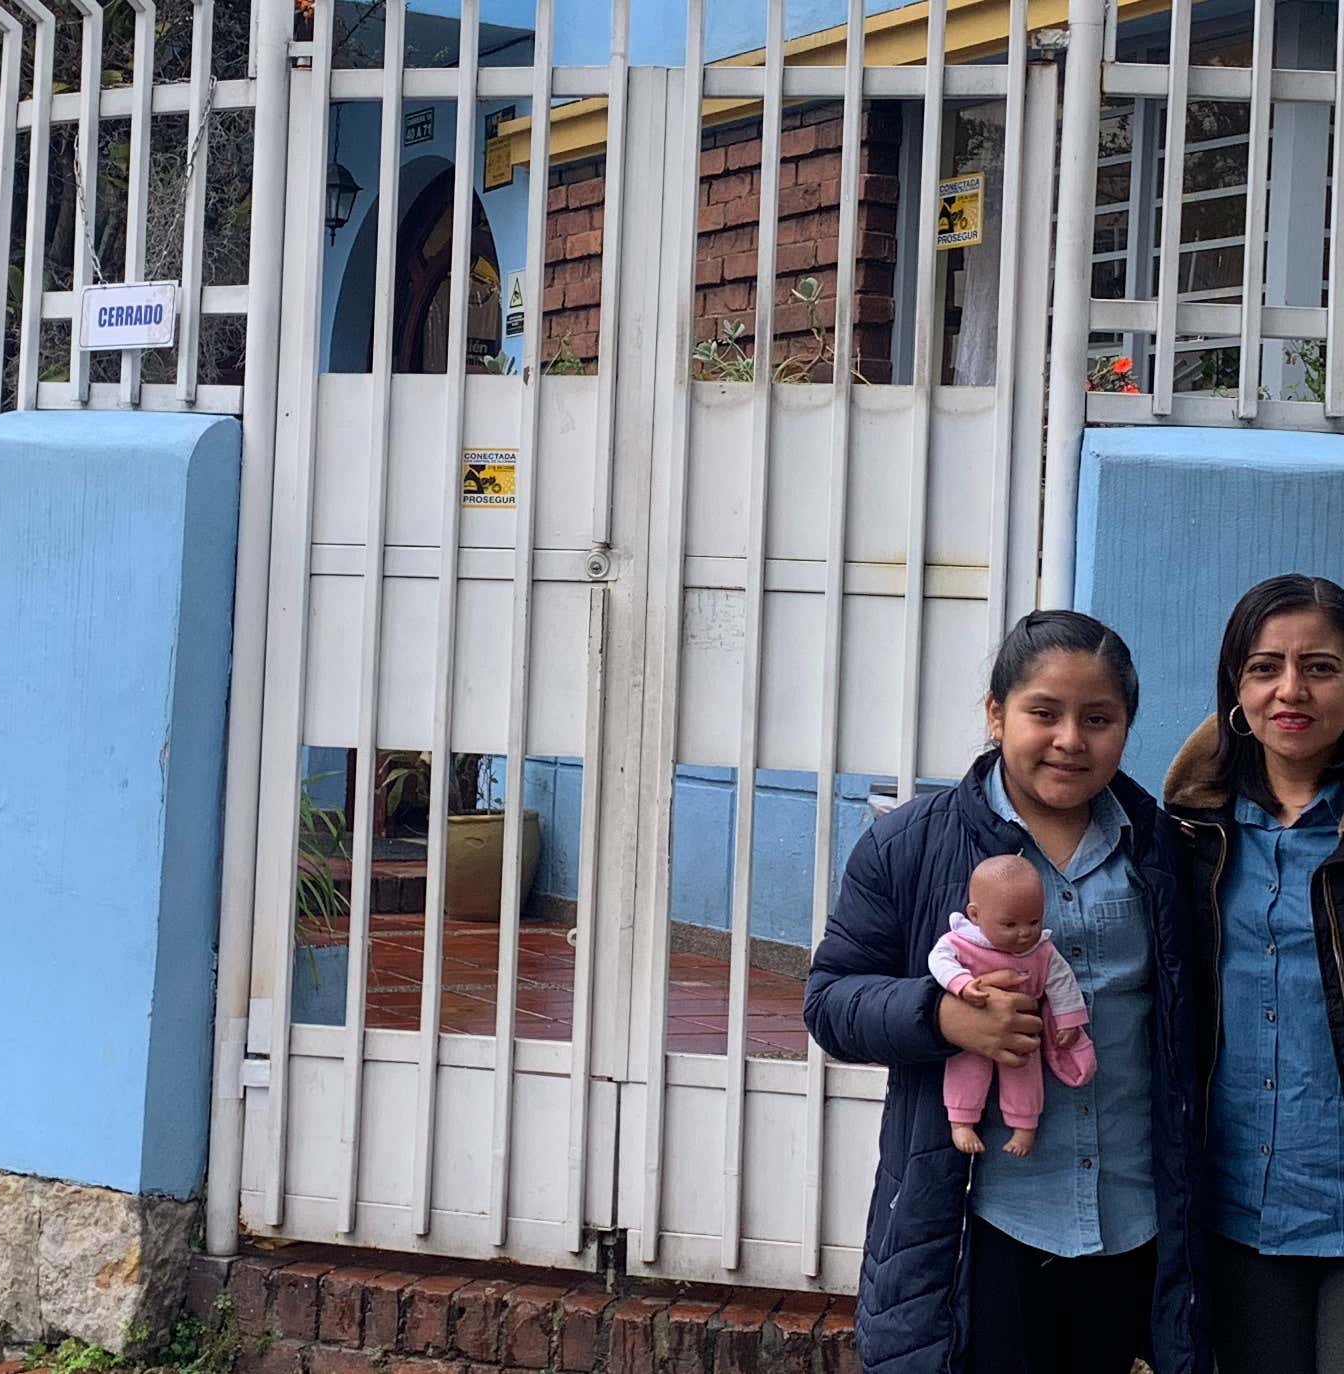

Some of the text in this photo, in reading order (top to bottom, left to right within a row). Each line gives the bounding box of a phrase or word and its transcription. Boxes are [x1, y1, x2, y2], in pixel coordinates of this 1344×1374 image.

[939, 178, 980, 193] CONECTADA
[937, 230, 978, 245] PROSEGUR
[98, 303, 163, 327] CERRADO
[464, 452, 516, 460] CONECTADA
[463, 495, 516, 504] PROSEGUR
